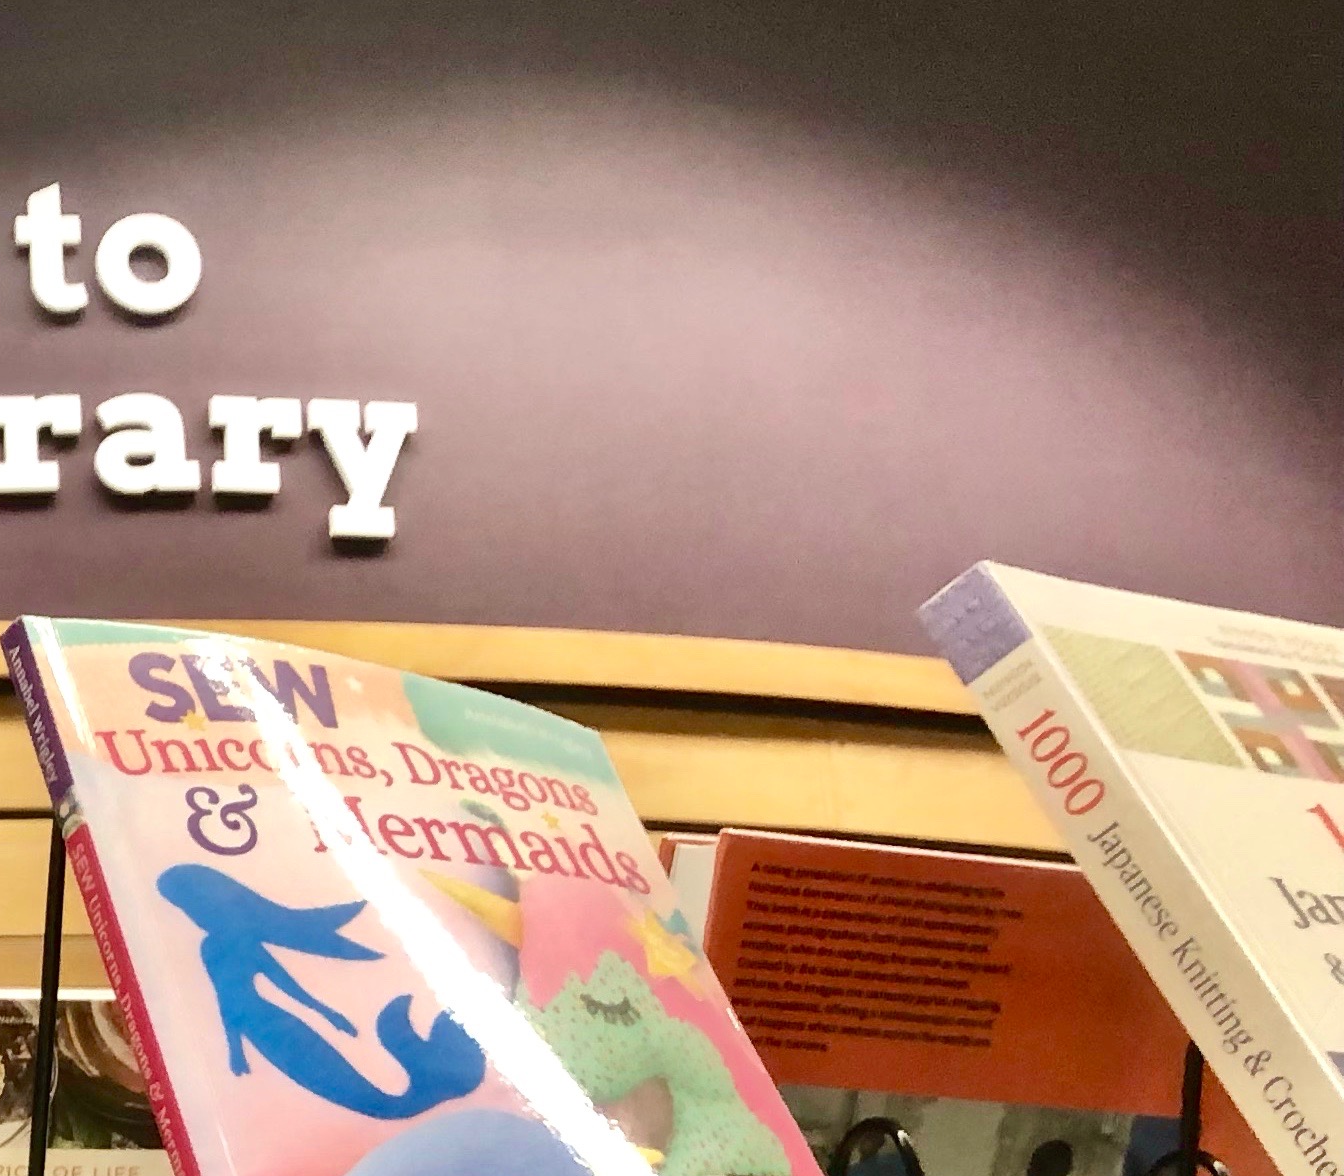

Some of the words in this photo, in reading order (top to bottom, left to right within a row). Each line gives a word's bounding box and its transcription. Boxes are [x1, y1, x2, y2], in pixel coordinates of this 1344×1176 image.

[12, 181, 202, 315] to
[185, 784, 258, 856] &
[393, 740, 600, 818] Dragons
[1016, 709, 1106, 816] 1000
[1087, 820, 1179, 941] Japanese
[1170, 937, 1255, 1054] Knitting
[1243, 1048, 1273, 1078] &
